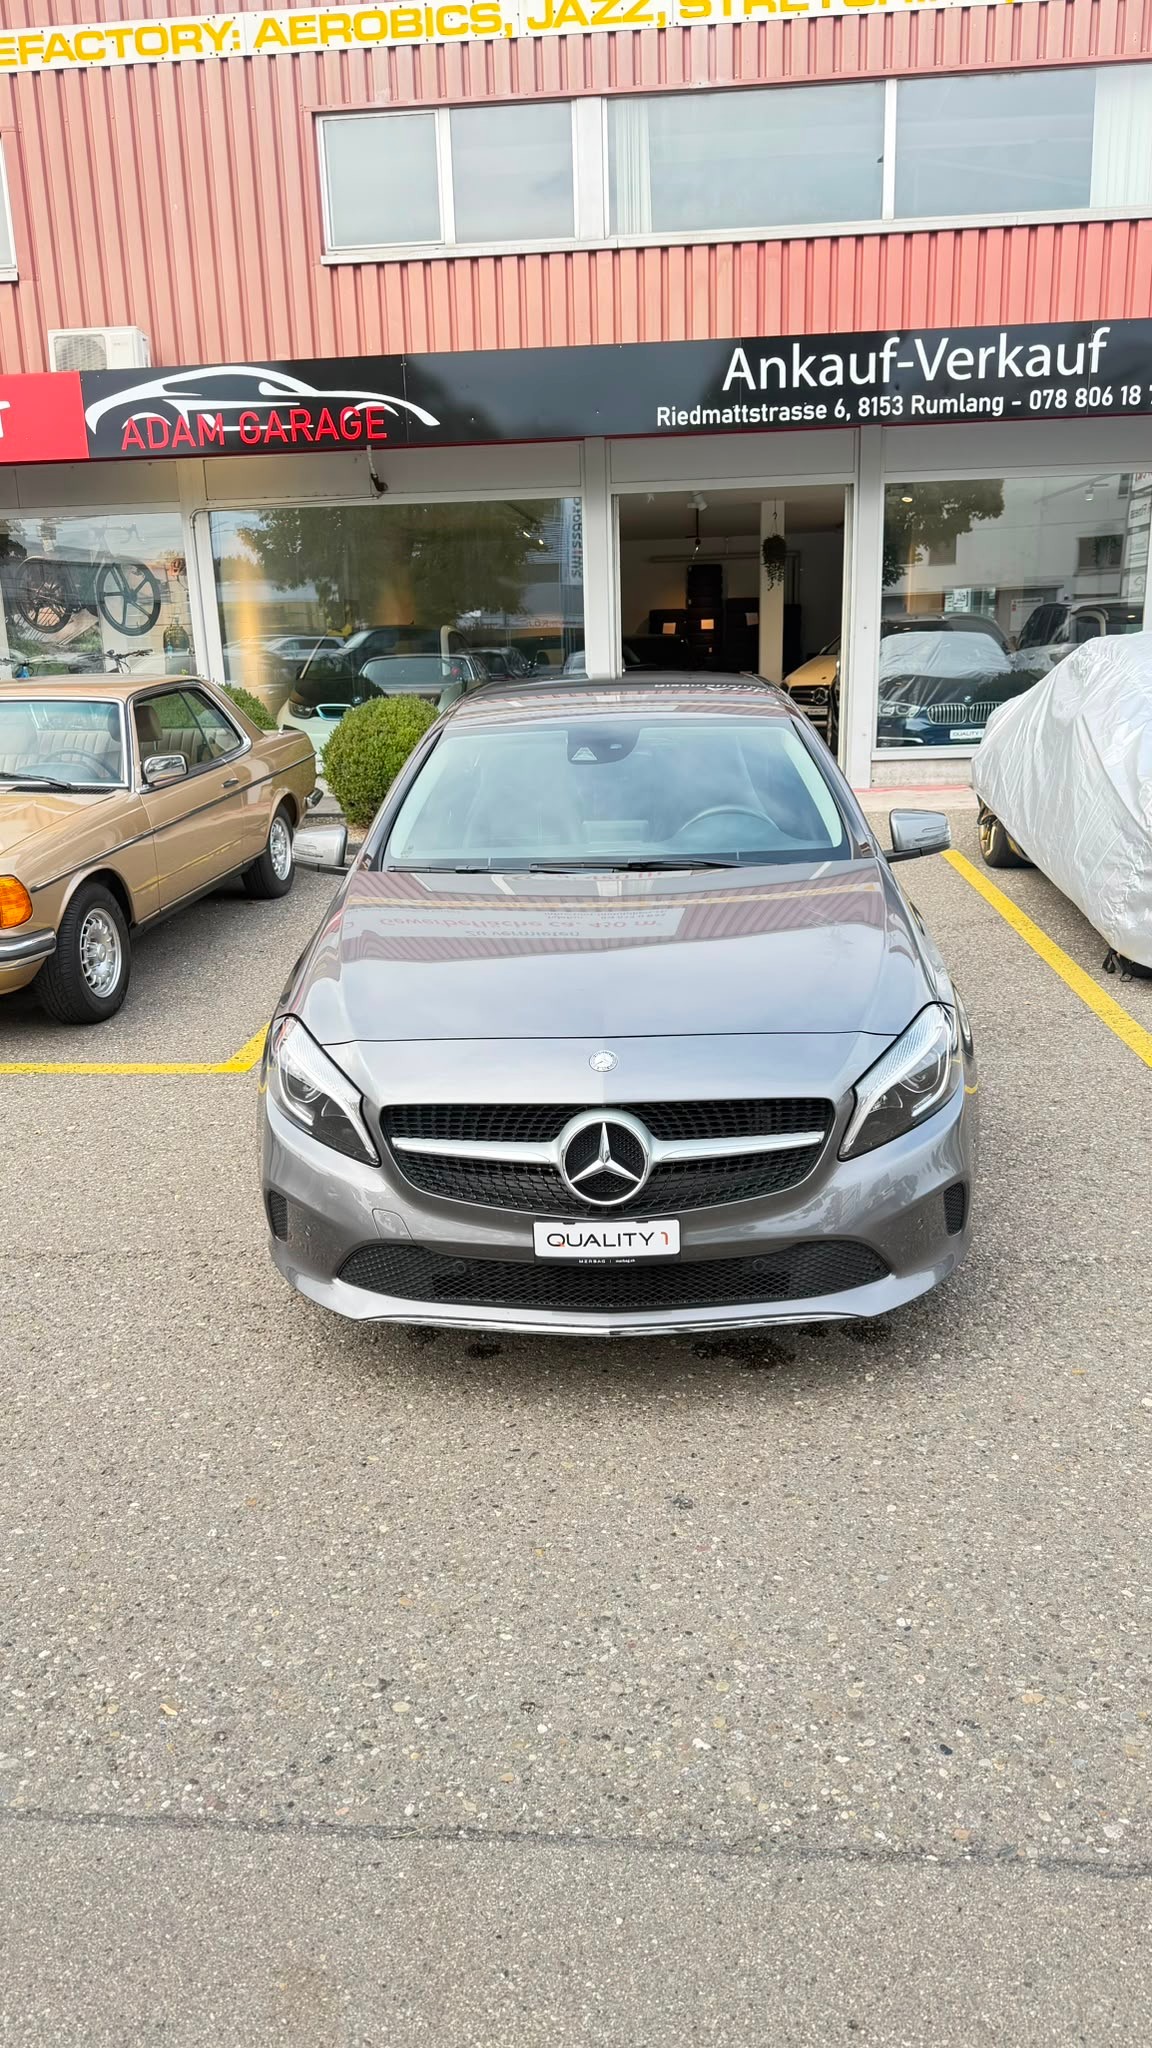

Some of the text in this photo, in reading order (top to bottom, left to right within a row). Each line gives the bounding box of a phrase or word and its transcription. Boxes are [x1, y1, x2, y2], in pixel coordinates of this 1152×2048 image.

[254, 3, 512, 48] AEROBICS,
[528, 0, 666, 30] JAZZ,
[722, 327, 1111, 392] Ankauf-Verkauf
[657, 403, 828, 426] Riedmattstrasse
[834, 398, 851, 421] 6,
[858, 396, 904, 417] 8153
[911, 393, 1004, 416] Rumlang
[1029, 389, 1068, 410] 078
[1074, 386, 1114, 408] 806
[1120, 385, 1142, 406] 18
[121, 406, 388, 450] ADAM GARAGE
[547, 1231, 668, 1247] QUALITY 1
